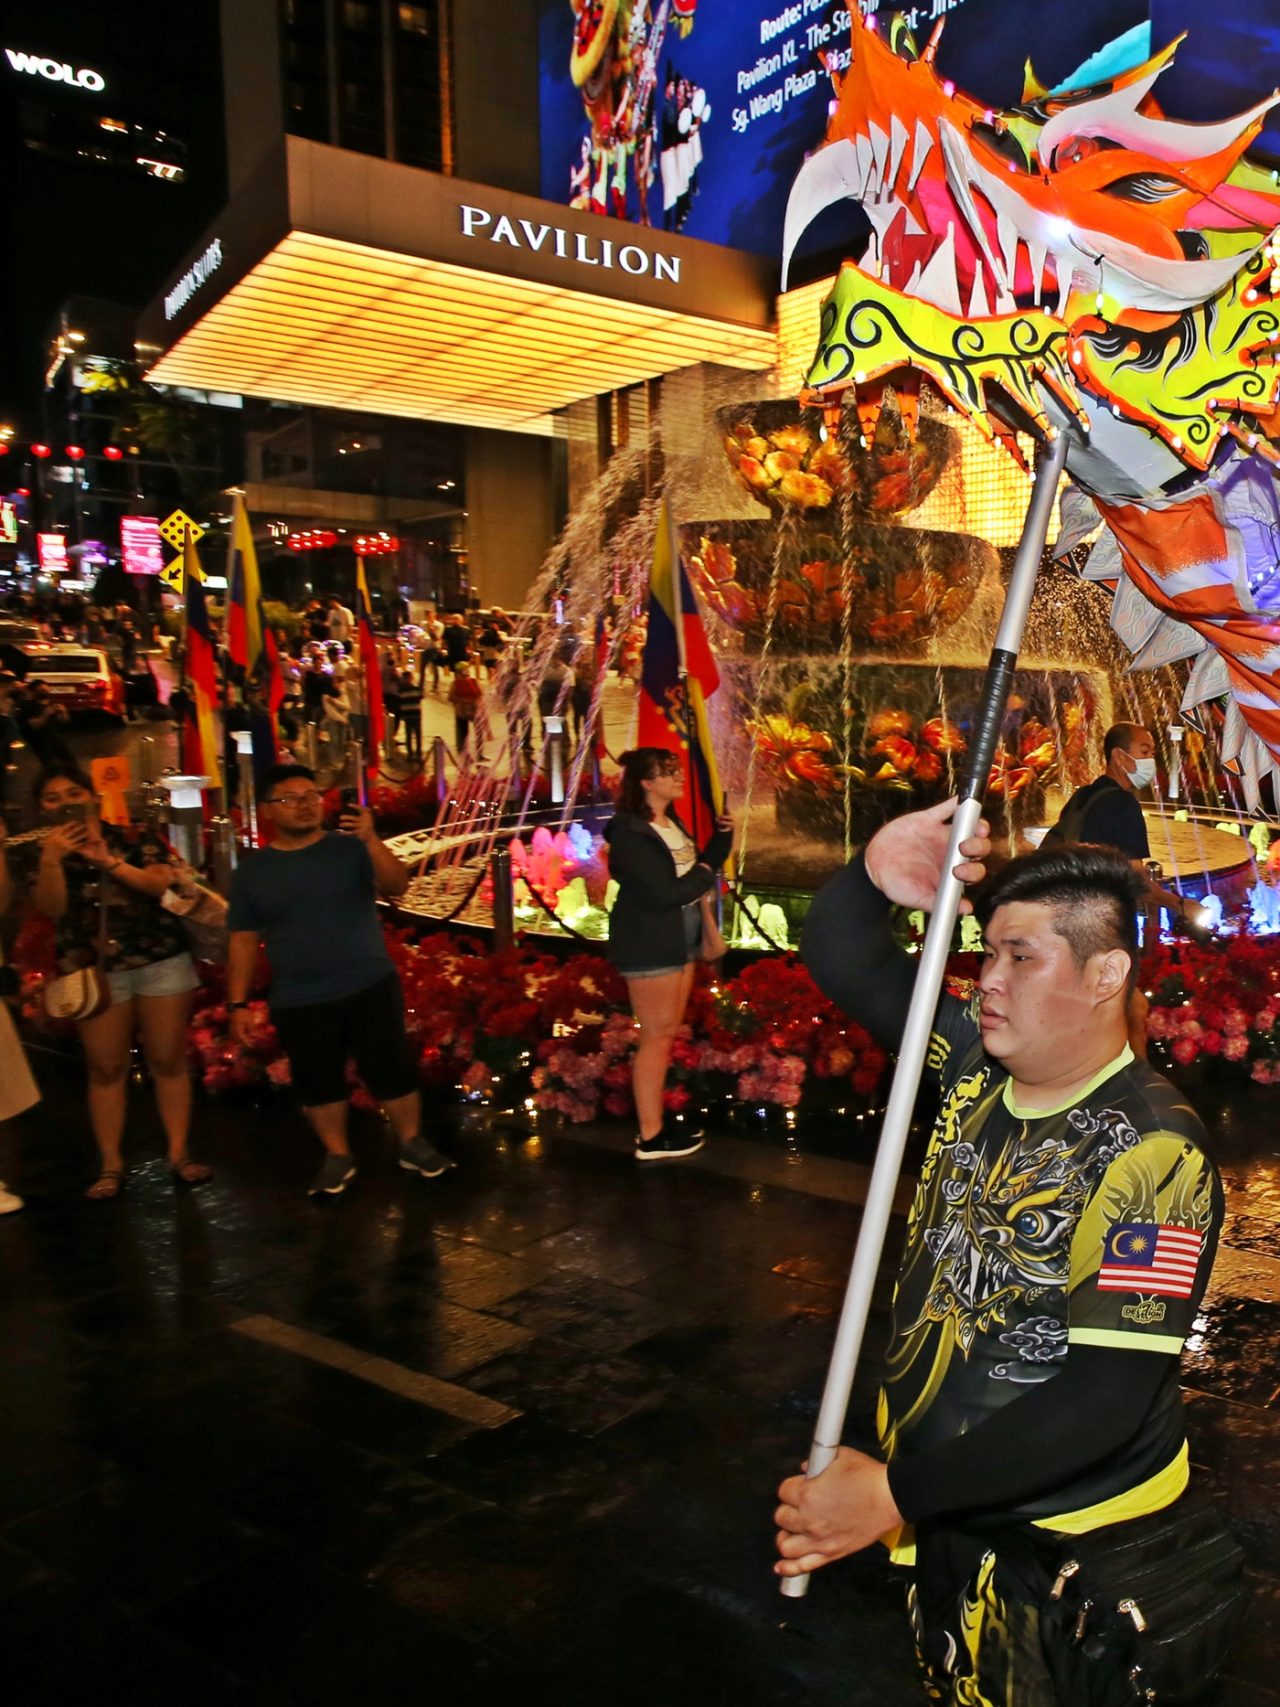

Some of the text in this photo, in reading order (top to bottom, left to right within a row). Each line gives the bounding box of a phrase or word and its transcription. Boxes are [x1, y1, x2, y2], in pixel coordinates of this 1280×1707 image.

[737, 53, 781, 93] Pavilion
[782, 39, 799, 66] KL
[806, 23, 831, 51] The
[760, 3, 802, 44] Route:
[5, 49, 105, 91] WOLO
[732, 107, 750, 133] Sg.
[749, 88, 783, 120] Wang
[784, 69, 817, 101] Plaza
[826, 48, 852, 78] Plaz
[460, 204, 681, 284] PAVILION
